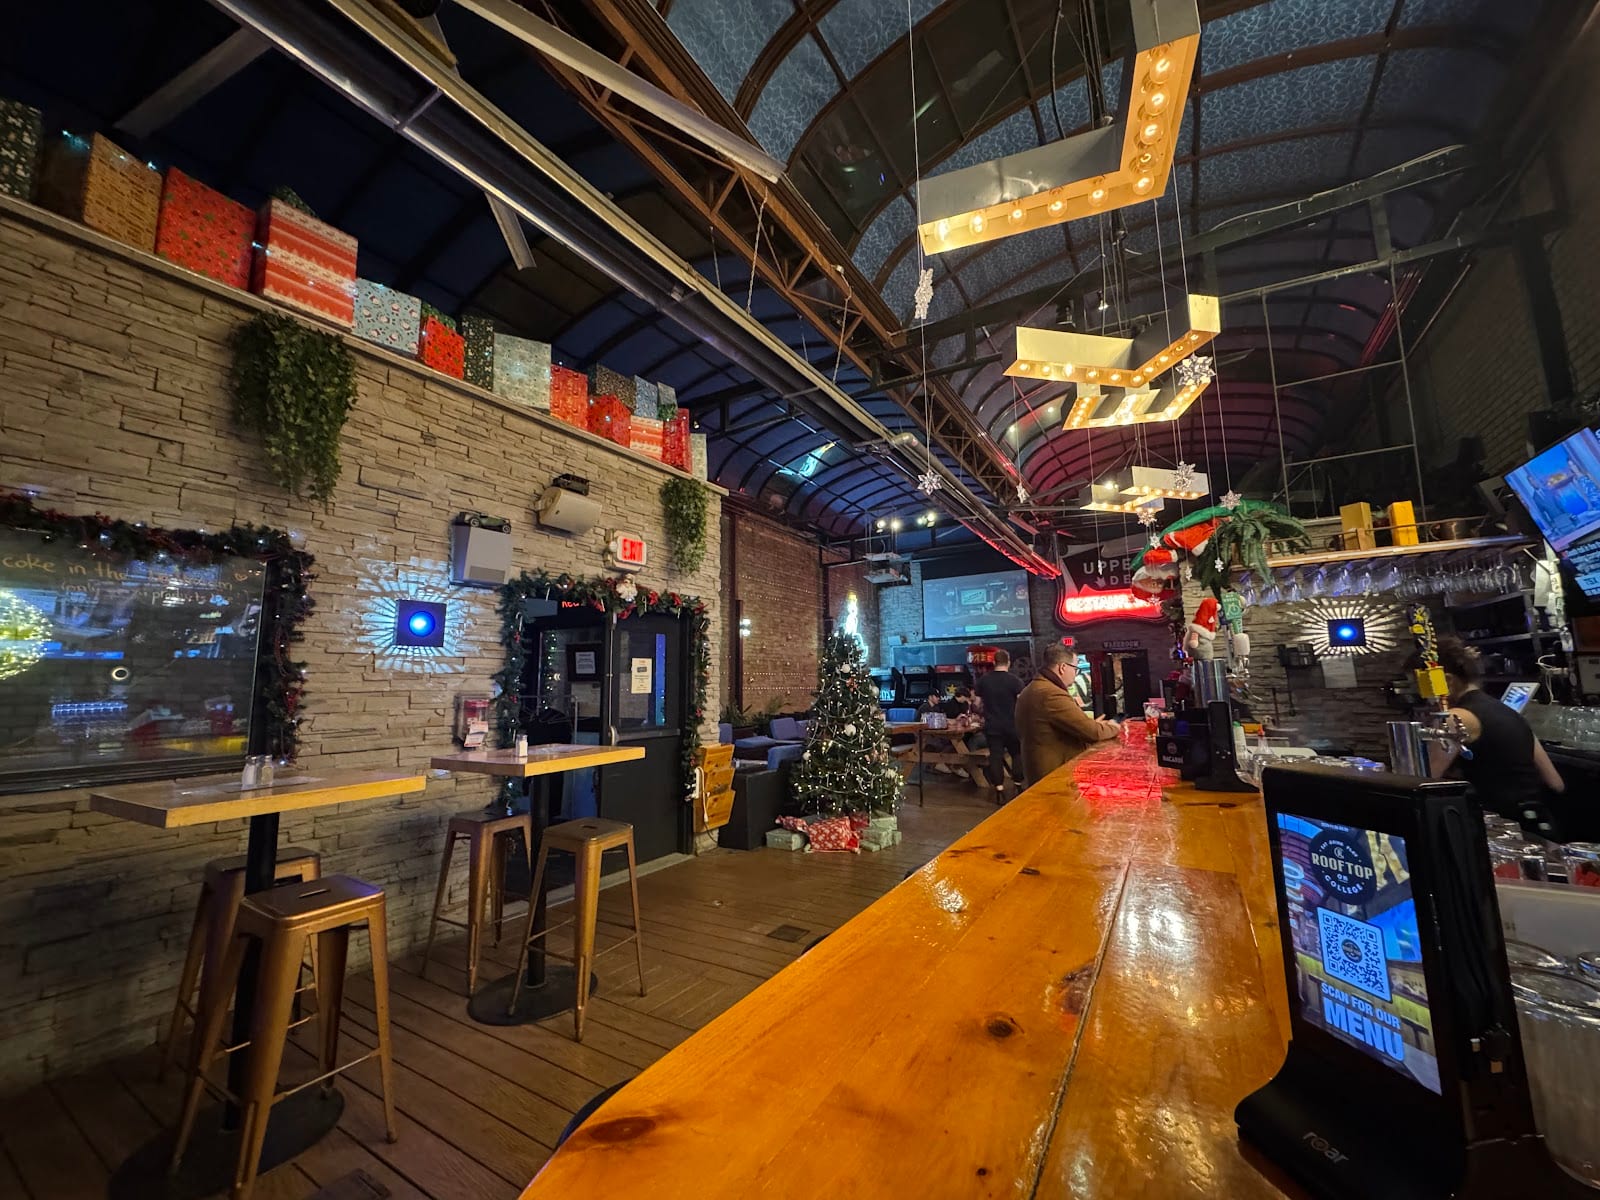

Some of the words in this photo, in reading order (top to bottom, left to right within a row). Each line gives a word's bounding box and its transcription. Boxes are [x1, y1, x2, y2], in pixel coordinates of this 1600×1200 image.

[622, 538, 643, 562] EXIT
[2, 553, 56, 574] coke
[67, 561, 87, 576] in
[1083, 558, 1131, 574] UPPE
[1110, 575, 1131, 586] DE
[1311, 852, 1373, 879] ROOFTOP
[1324, 875, 1363, 894] COLLEGE
[1321, 982, 1350, 1005] SCAN
[1351, 996, 1374, 1017] FOR
[1376, 1007, 1402, 1030] OUR
[1323, 996, 1406, 1062] MENU
[1303, 1131, 1350, 1164] roar
